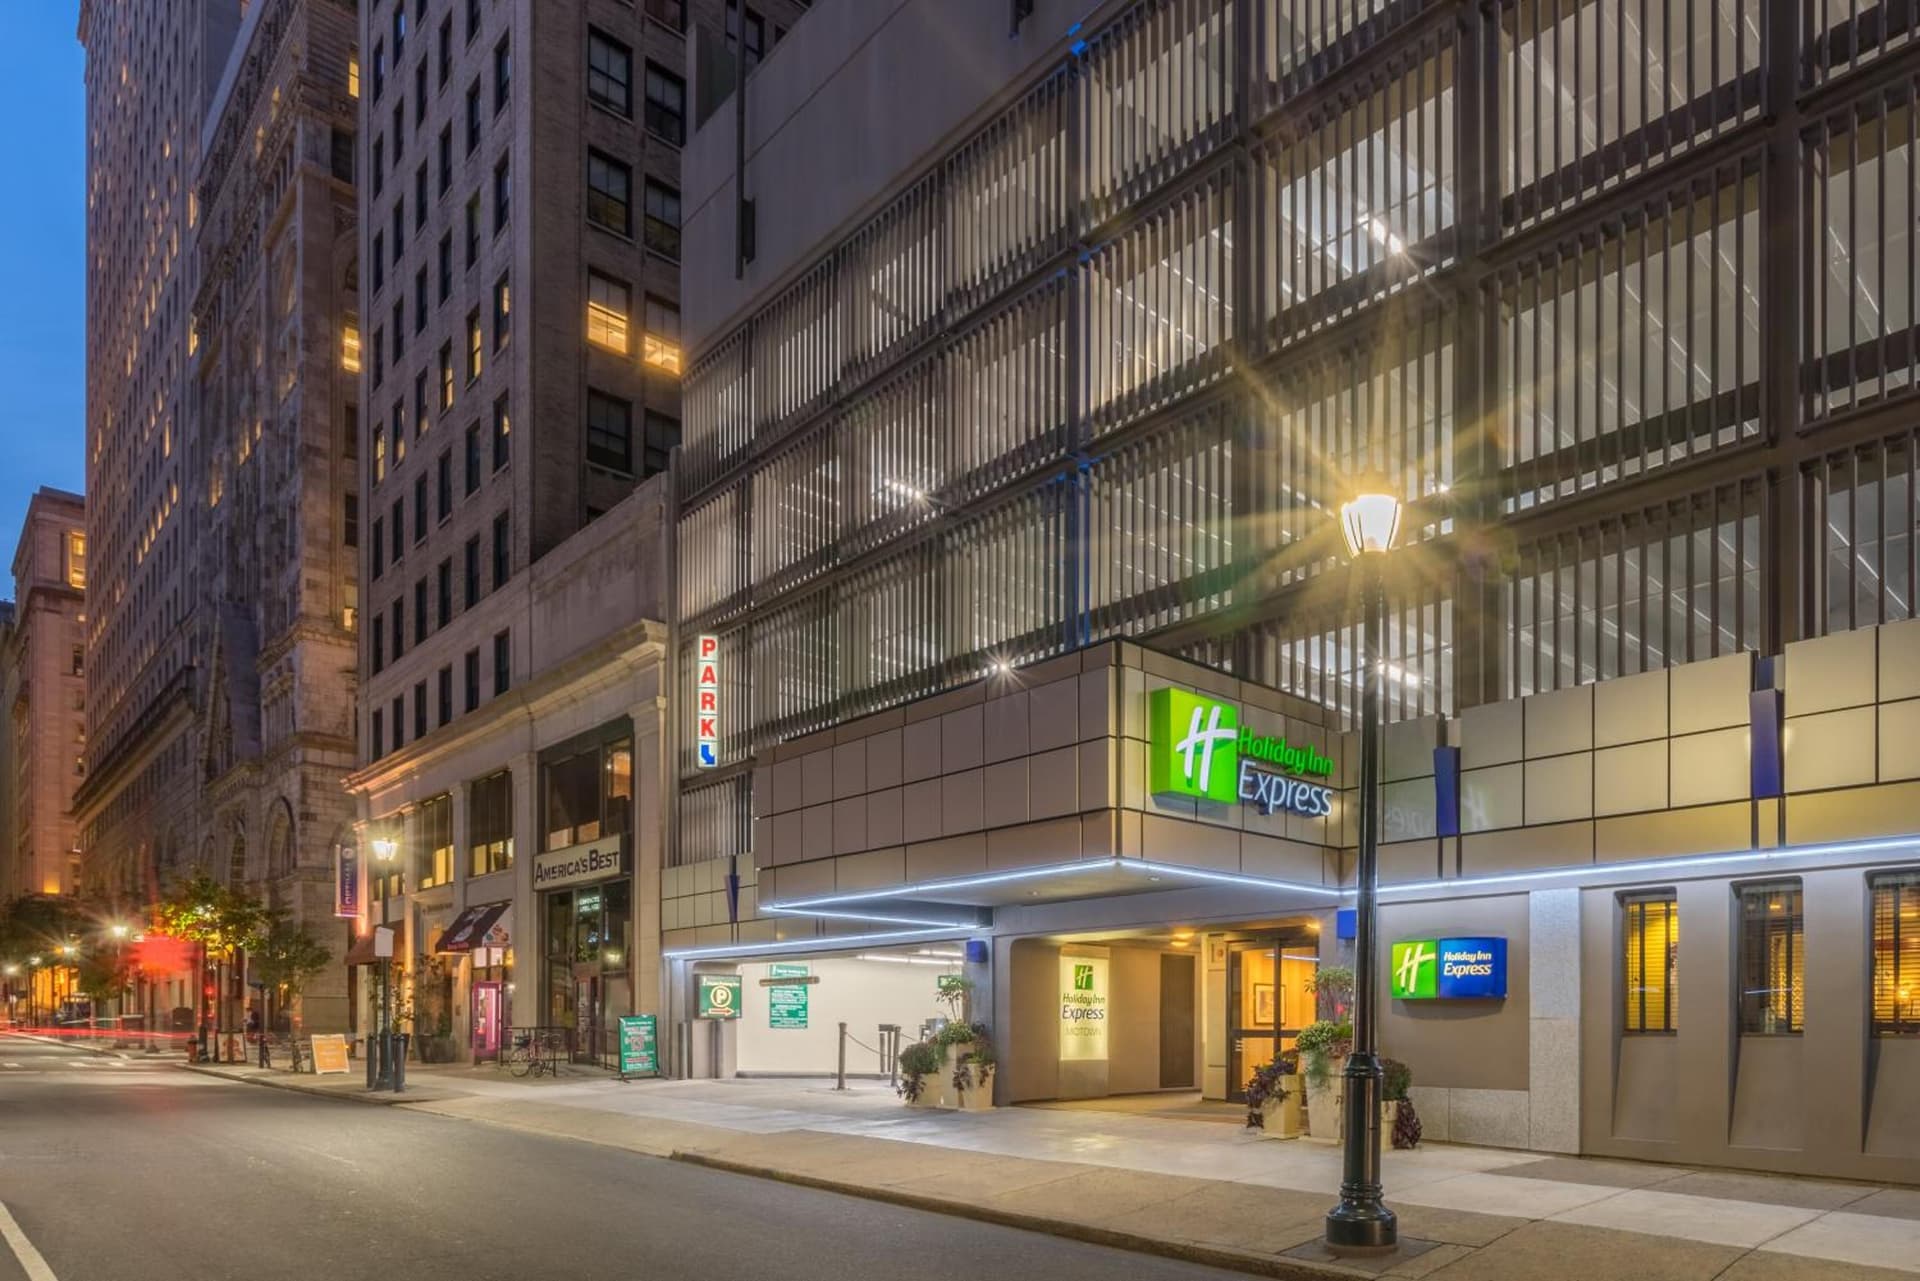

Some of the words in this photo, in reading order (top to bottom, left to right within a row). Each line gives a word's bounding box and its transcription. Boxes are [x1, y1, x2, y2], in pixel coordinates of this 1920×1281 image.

[701, 638, 716, 737] PARK
[1239, 725, 1306, 776] Holiday
[1308, 744, 1335, 777] Inn
[1238, 759, 1334, 816] Express
[1443, 951, 1477, 963] Holiday
[1477, 950, 1492, 961] Inn
[1443, 963, 1493, 979] Express
[716, 989, 728, 1004] P
[1062, 993, 1092, 1006] Holiday
[1092, 993, 1105, 1004] Inn
[1062, 1004, 1104, 1023] Express
